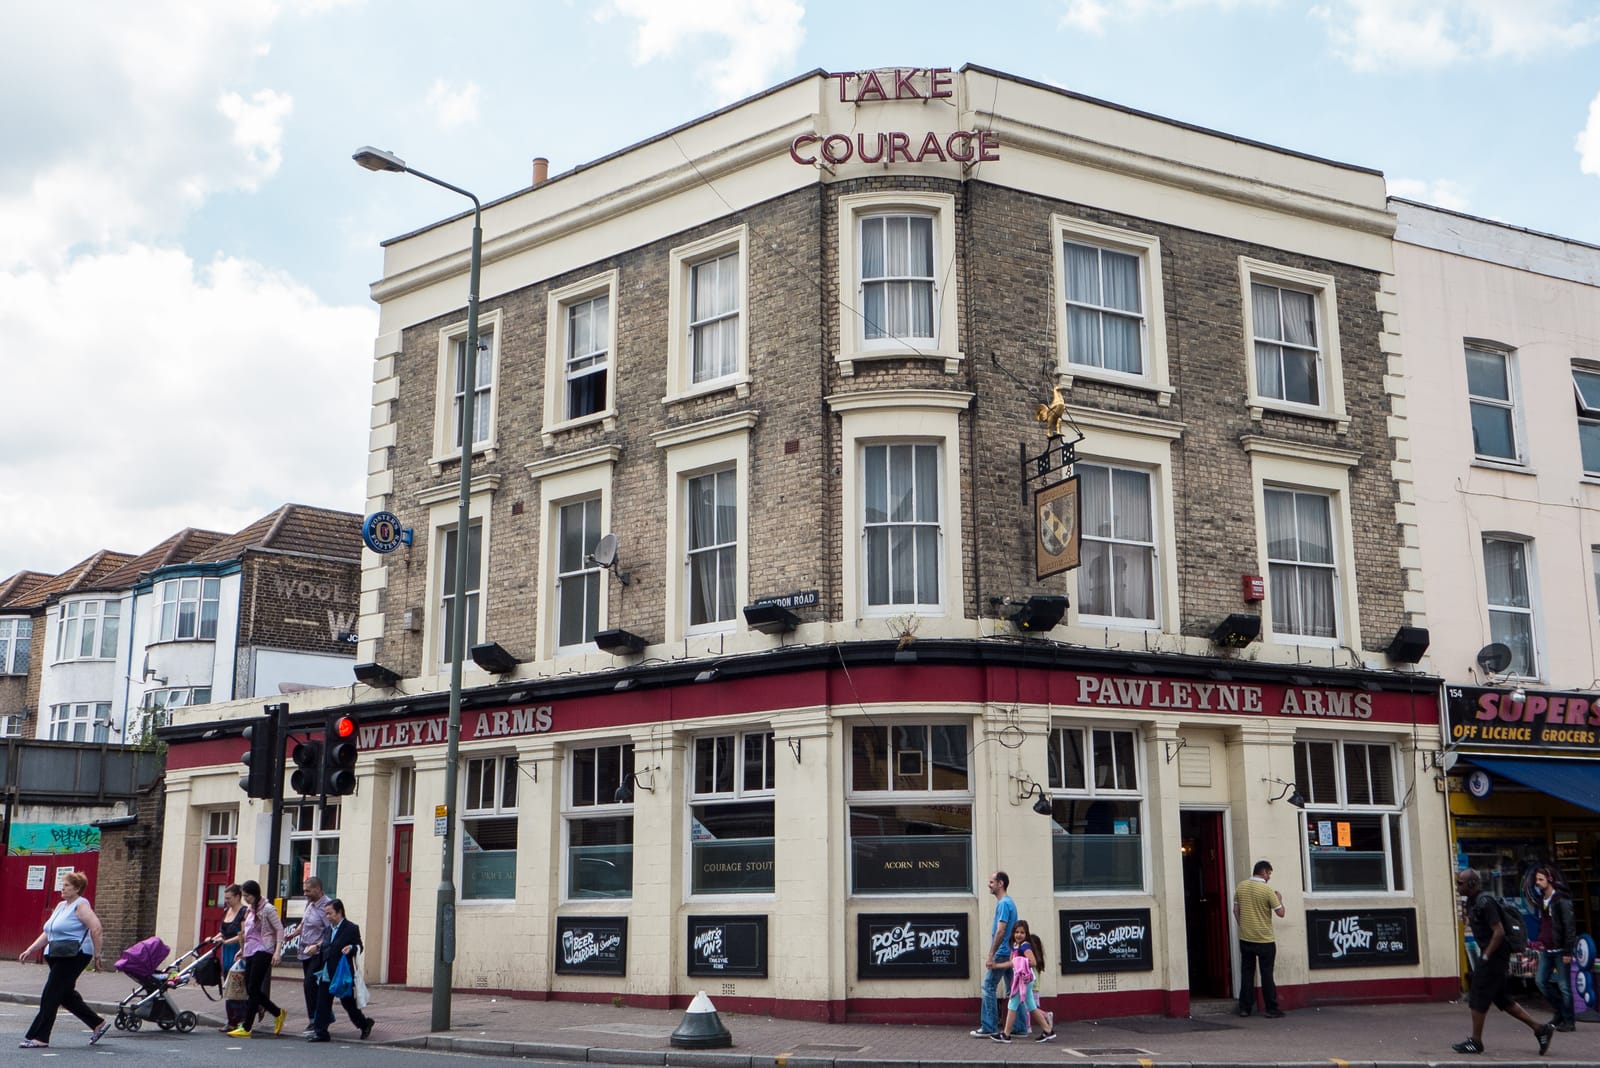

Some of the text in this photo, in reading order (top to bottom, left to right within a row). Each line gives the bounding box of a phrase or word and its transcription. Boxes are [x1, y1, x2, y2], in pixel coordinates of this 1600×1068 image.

[829, 67, 953, 103] TAKE
[789, 131, 1001, 165] COURAGE
[794, 594, 815, 606] ROAD
[1076, 675, 1373, 719] PAWLEYNE ARMS
[1449, 689, 1463, 698] 154
[474, 706, 553, 737] ARMS
[1453, 724, 1595, 744] OFF LICENCE GROCERS
[703, 861, 774, 873] COURAGE STOUT
[884, 861, 940, 870] ACORN INNS
[694, 927, 722, 950] WHAT'S
[871, 921, 915, 951] POOL
[918, 928, 960, 949] DARTS
[1085, 925, 1145, 950] BEER GARDEN
[1329, 915, 1360, 940] LIVE
[573, 932, 594, 950] BEER
[703, 939, 722, 957] ON?
[875, 937, 915, 965] TABLE
[1332, 929, 1374, 958] SPORT
[573, 942, 599, 964] GARDEN
